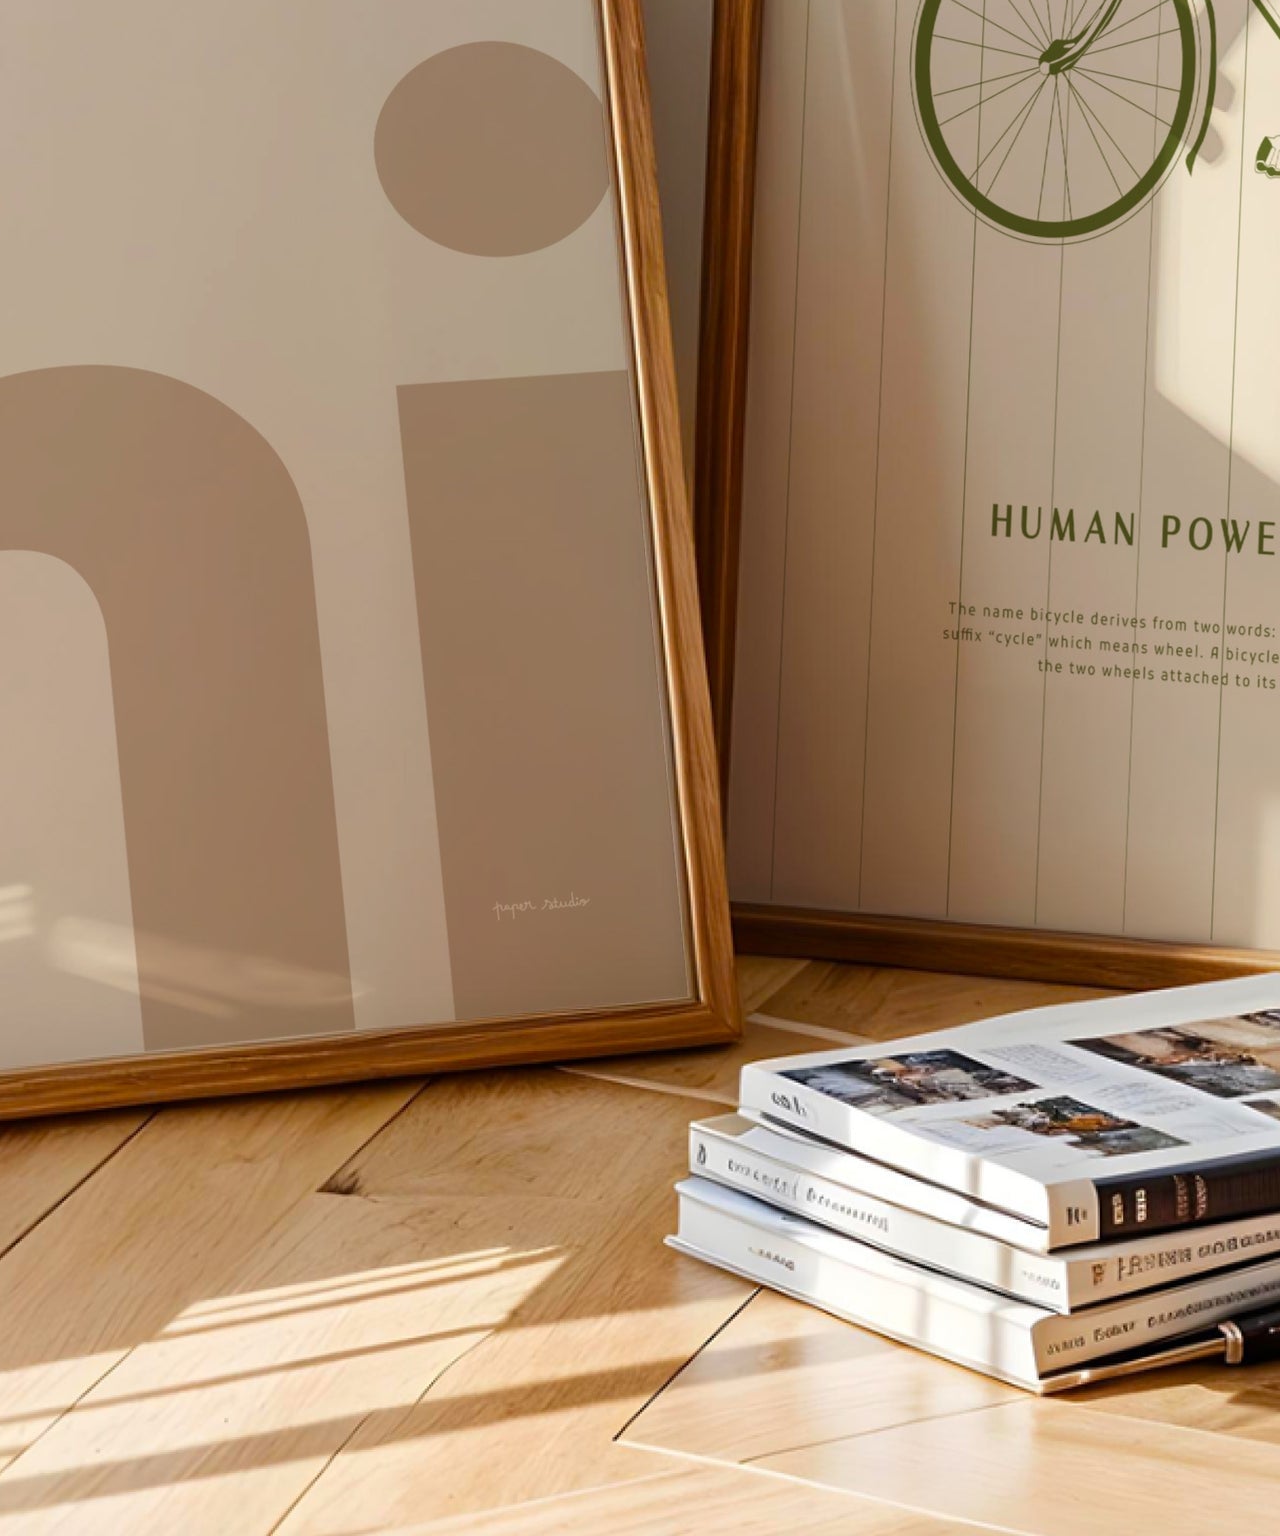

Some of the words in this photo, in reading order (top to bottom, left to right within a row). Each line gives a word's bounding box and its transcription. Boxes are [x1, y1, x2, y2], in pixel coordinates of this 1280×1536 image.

[991, 503, 1135, 546] HUMAN
[948, 601, 976, 616] The
[983, 606, 1024, 620] name
[1030, 607, 1085, 626] bicycle
[1090, 611, 1147, 629] derives
[1152, 616, 1187, 632] from
[1193, 620, 1220, 634] two
[1226, 623, 1276, 638] words:
[942, 627, 982, 642] suffix
[1048, 635, 1092, 650] which
[1099, 640, 1148, 654] means
[1153, 643, 1204, 659] wheel.
[1210, 646, 1219, 660] A
[1226, 647, 1280, 665] bicycle
[1038, 659, 1062, 673] the
[1069, 661, 1096, 676] two
[1102, 664, 1154, 680] wheels
[1160, 669, 1229, 686] attached
[1235, 673, 1250, 688] to
[1257, 674, 1276, 689] its
